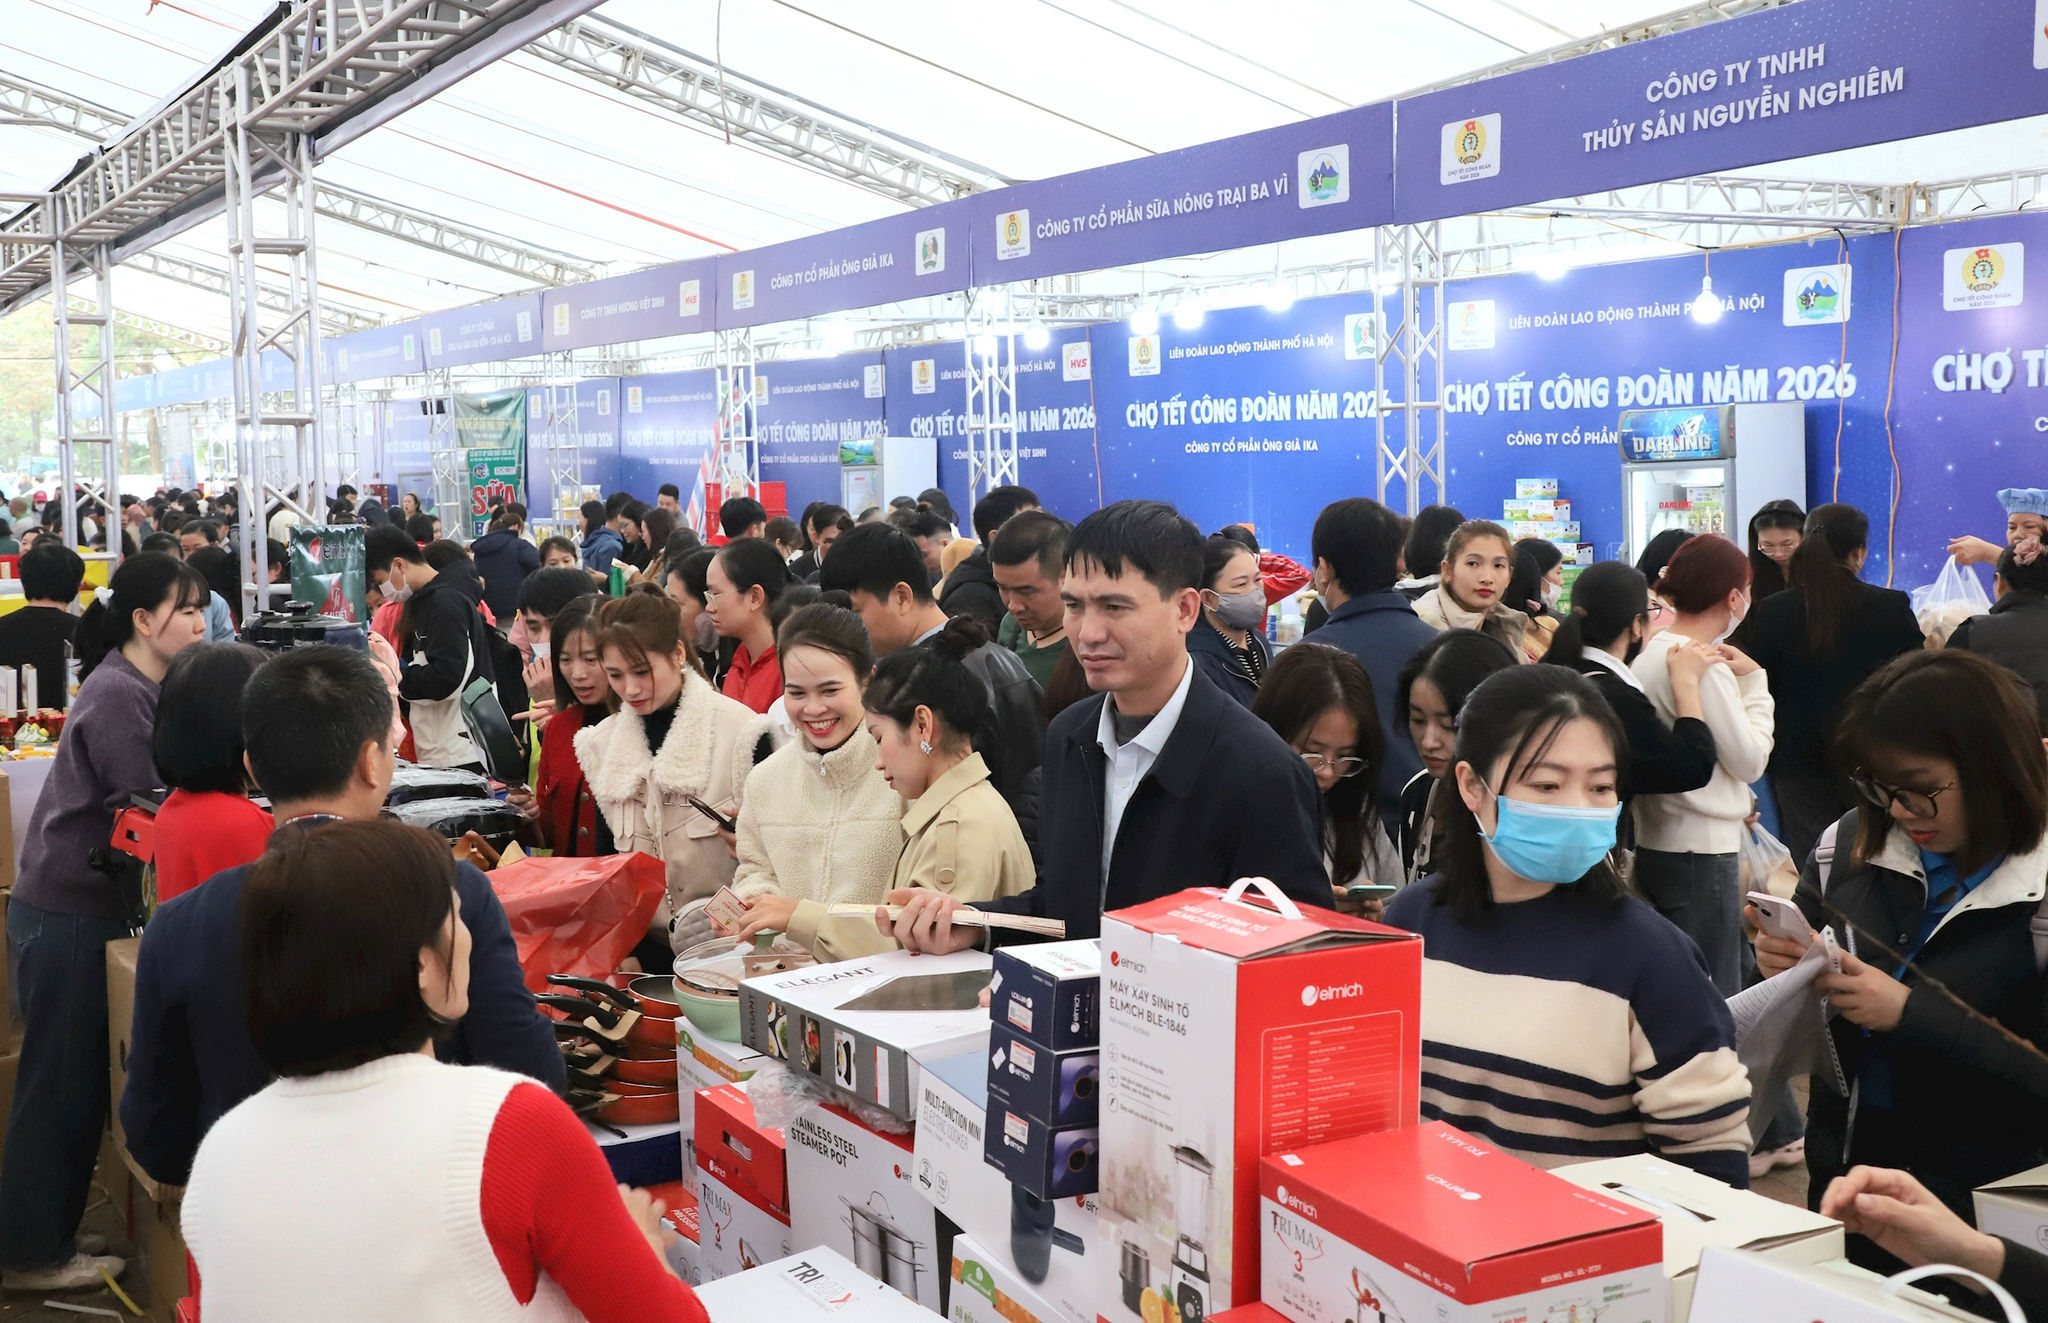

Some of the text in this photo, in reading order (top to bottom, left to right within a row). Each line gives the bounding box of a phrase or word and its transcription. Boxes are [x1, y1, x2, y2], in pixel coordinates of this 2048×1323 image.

[1646, 43, 1825, 102] CÔNG TY TNHH
[1582, 66, 1904, 152] THỦY SẢN NGUYỄN NGHIÊM
[1037, 172, 1289, 239] CÔNG TY CỔ PHẦN SỮA NÔNG TRẠI BA VÌ
[771, 252, 894, 289] CÔNG TY CỔ PHẦN ÔNG GIÀ IKA
[1509, 313, 1531, 329] LIÊN
[1534, 311, 1568, 328] ĐOÀN
[1571, 311, 1594, 325] LAO
[1597, 306, 1634, 325] ĐỘNG
[1638, 302, 1680, 318] THÀNH
[1740, 294, 1765, 313] NỘI
[1169, 332, 1333, 359] LIÊN ĐOÀN LAO ĐỘNG THÀNH PHỐ HÀ NỘI
[1070, 358, 1088, 368] HVS
[1933, 346, 2014, 393] CHỢ
[1444, 362, 1857, 415] CHỢ TẾT CÔNG ĐOÀN NĂM 2026
[911, 405, 1096, 437] CHỢ TẾT NĂM 2026
[1126, 389, 1338, 429] CHỢ TẾT CÔNG ĐOÀN NĂM
[769, 418, 862, 443] TẾT CÔNG ĐOÀN NĂM
[1507, 425, 1618, 446] CÔNG TY CỔ PHẦN
[1032, 448, 1047, 458] SINH
[1185, 436, 1318, 454] CÔNG TY CỔ PHẦN ÔNG GIÀ IKA
[1632, 434, 1711, 453] DARLING
[775, 967, 875, 989] ELEGANT
[1121, 958, 1146, 974] elmich
[1110, 978, 1189, 1018] MÁY XAY SINH TỐ
[1319, 982, 1363, 1001] elmich
[1110, 996, 1144, 1020] ELMICH
[1146, 1010, 1187, 1036] BLE-1846
[1014, 1067, 1031, 1081] elmich
[925, 1088, 968, 1132] MULTI-FUNCTION
[967, 1119, 981, 1142] MINI
[791, 1127, 847, 1168] STEAMER POT
[834, 1134, 859, 1159] STEEL
[1008, 1140, 1025, 1154] elmich
[702, 1183, 714, 1206] TRI
[1288, 1195, 1318, 1220] elmich
[714, 1222, 721, 1242] 3
[1271, 1210, 1323, 1250] TRI MAX
[1294, 1250, 1303, 1272] 3
